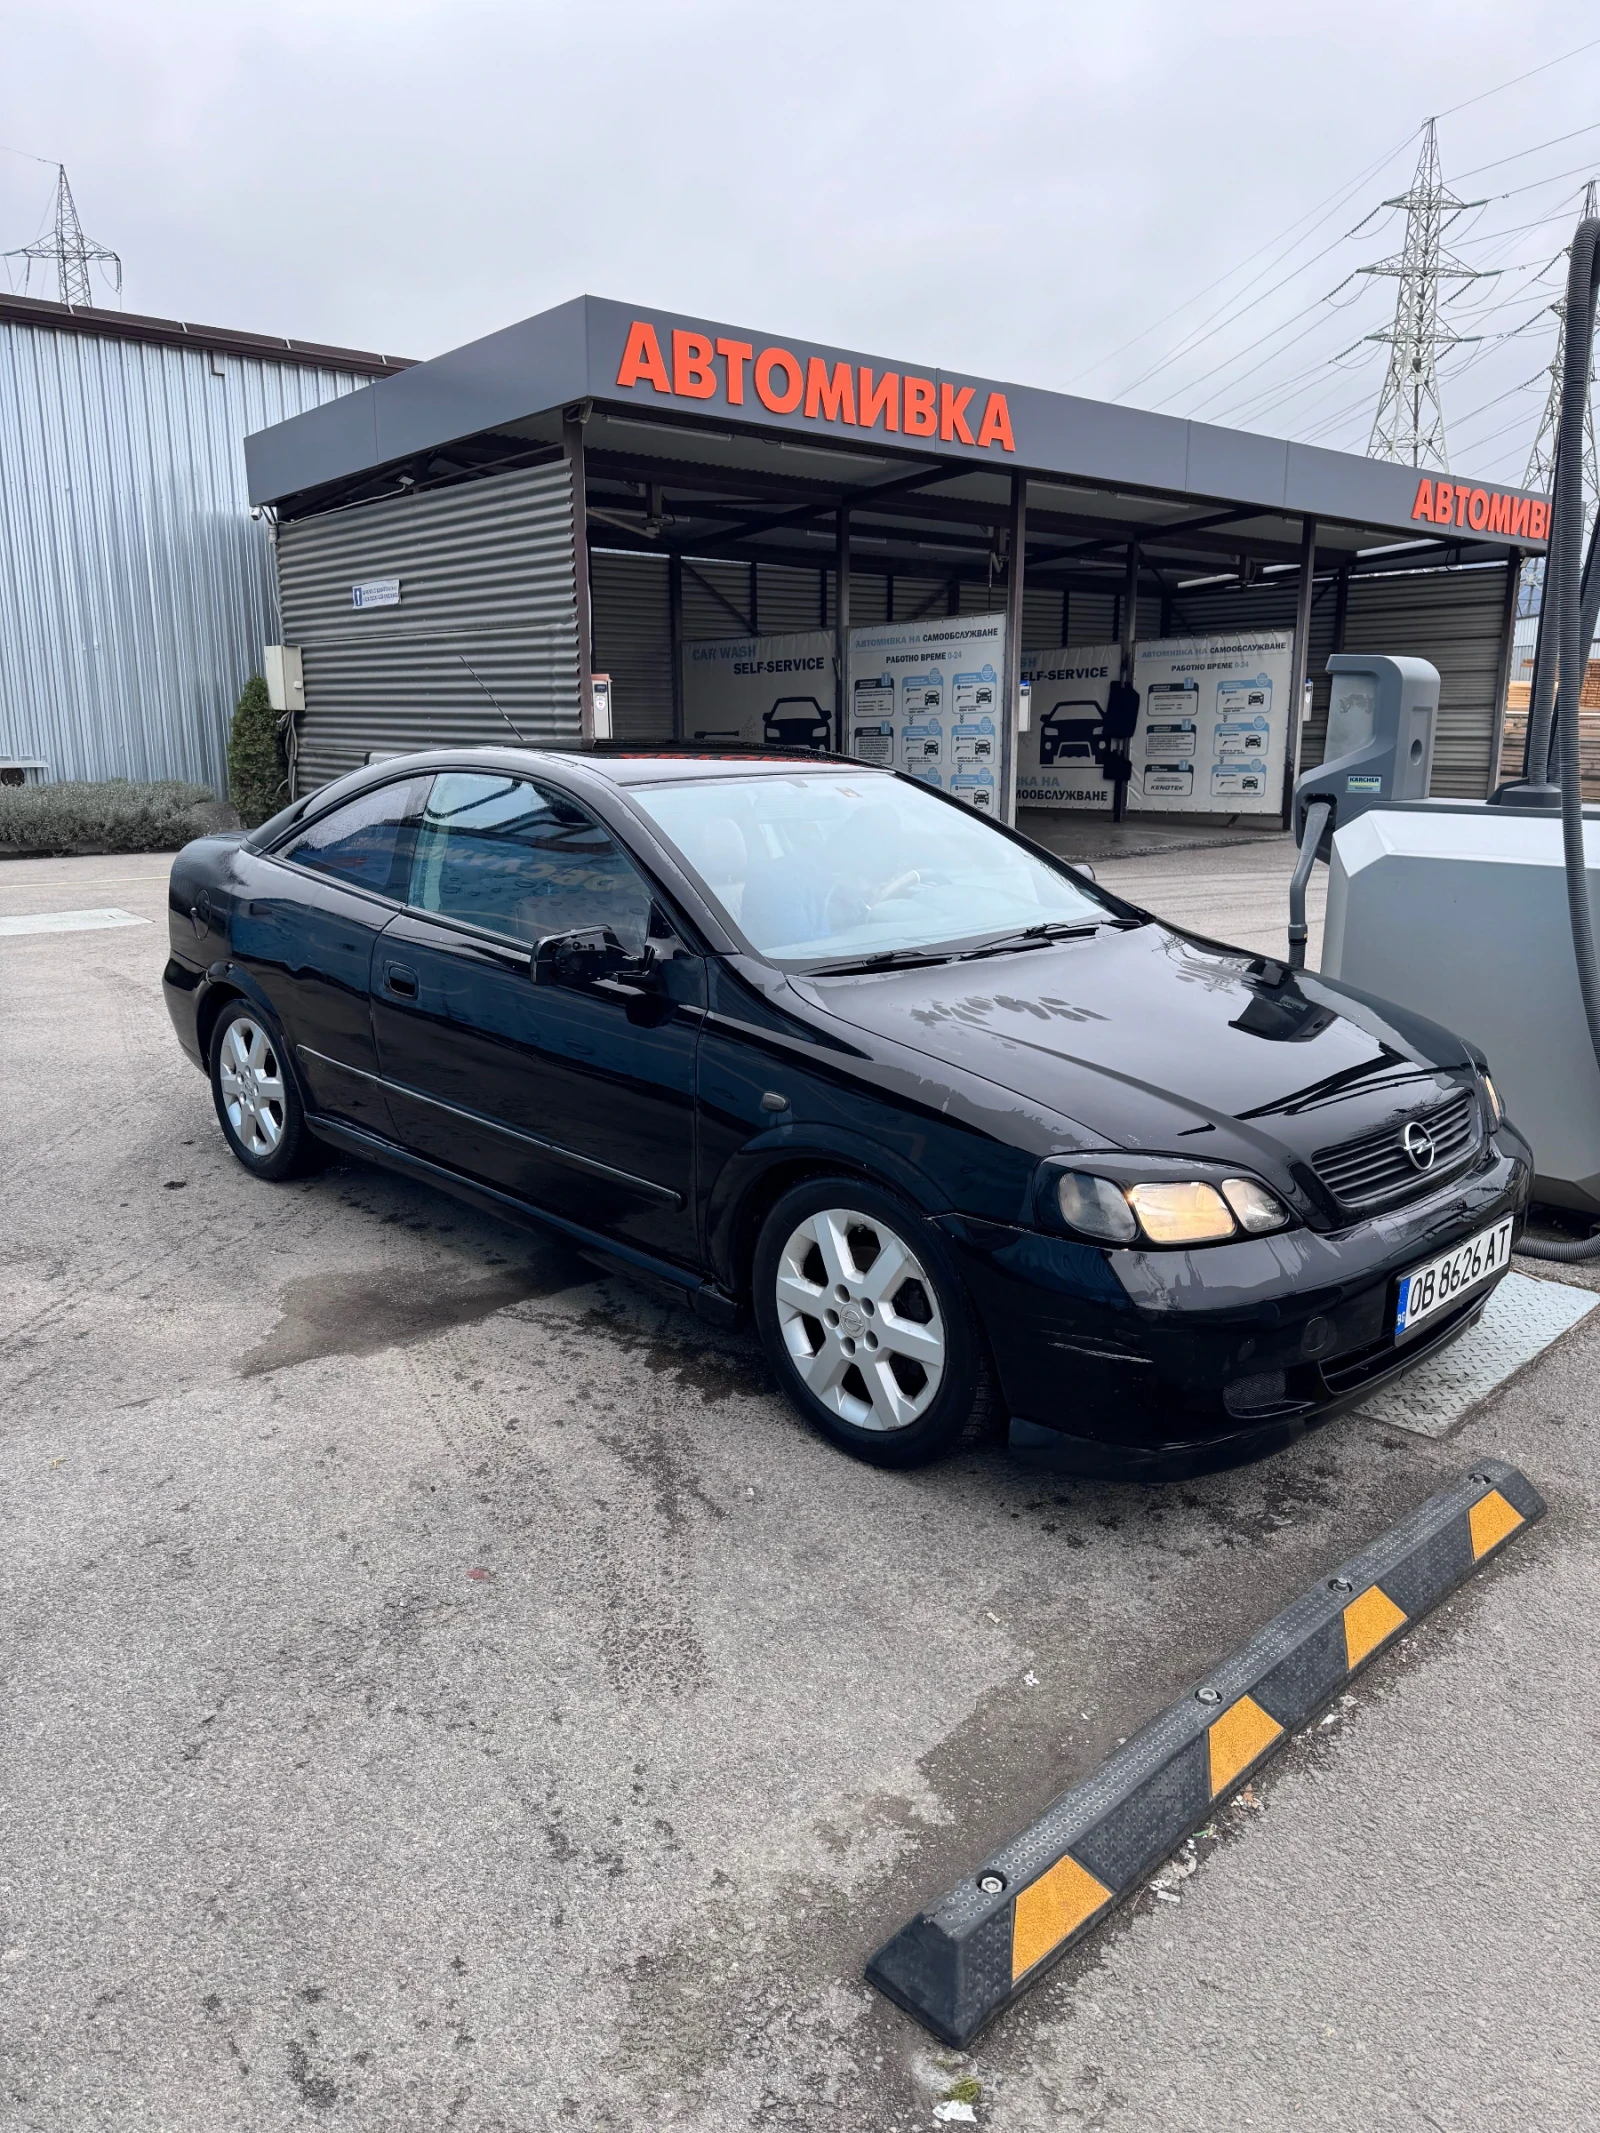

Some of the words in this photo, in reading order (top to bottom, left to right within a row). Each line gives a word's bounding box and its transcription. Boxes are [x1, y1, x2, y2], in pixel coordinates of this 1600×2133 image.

[616, 320, 1016, 453] АВТОМИВКА
[1411, 478, 1552, 541] АВТОМИВ
[856, 636, 907, 648] АВТОМИВКА
[909, 635, 921, 644] НА
[922, 628, 999, 642] САМООБСЛУЖВАНЕ
[692, 647, 716, 661] CAR
[720, 645, 757, 659] WASH
[1210, 642, 1287, 654] САМООБСЛУЖВАНЕ
[886, 653, 919, 664] РАБОТНО
[920, 652, 947, 662] ВРЕМЕ
[947, 651, 962, 659] 0-24
[733, 657, 825, 675] SELF-SERVICE
[1171, 664, 1205, 672] РАБОТНО
[1207, 662, 1233, 670] ВРЕМЕ
[1041, 776, 1060, 787] НА
[1438, 1240, 1482, 1299] 8626
[1484, 1224, 1510, 1272] AT
[1397, 1311, 1406, 1326] BG
